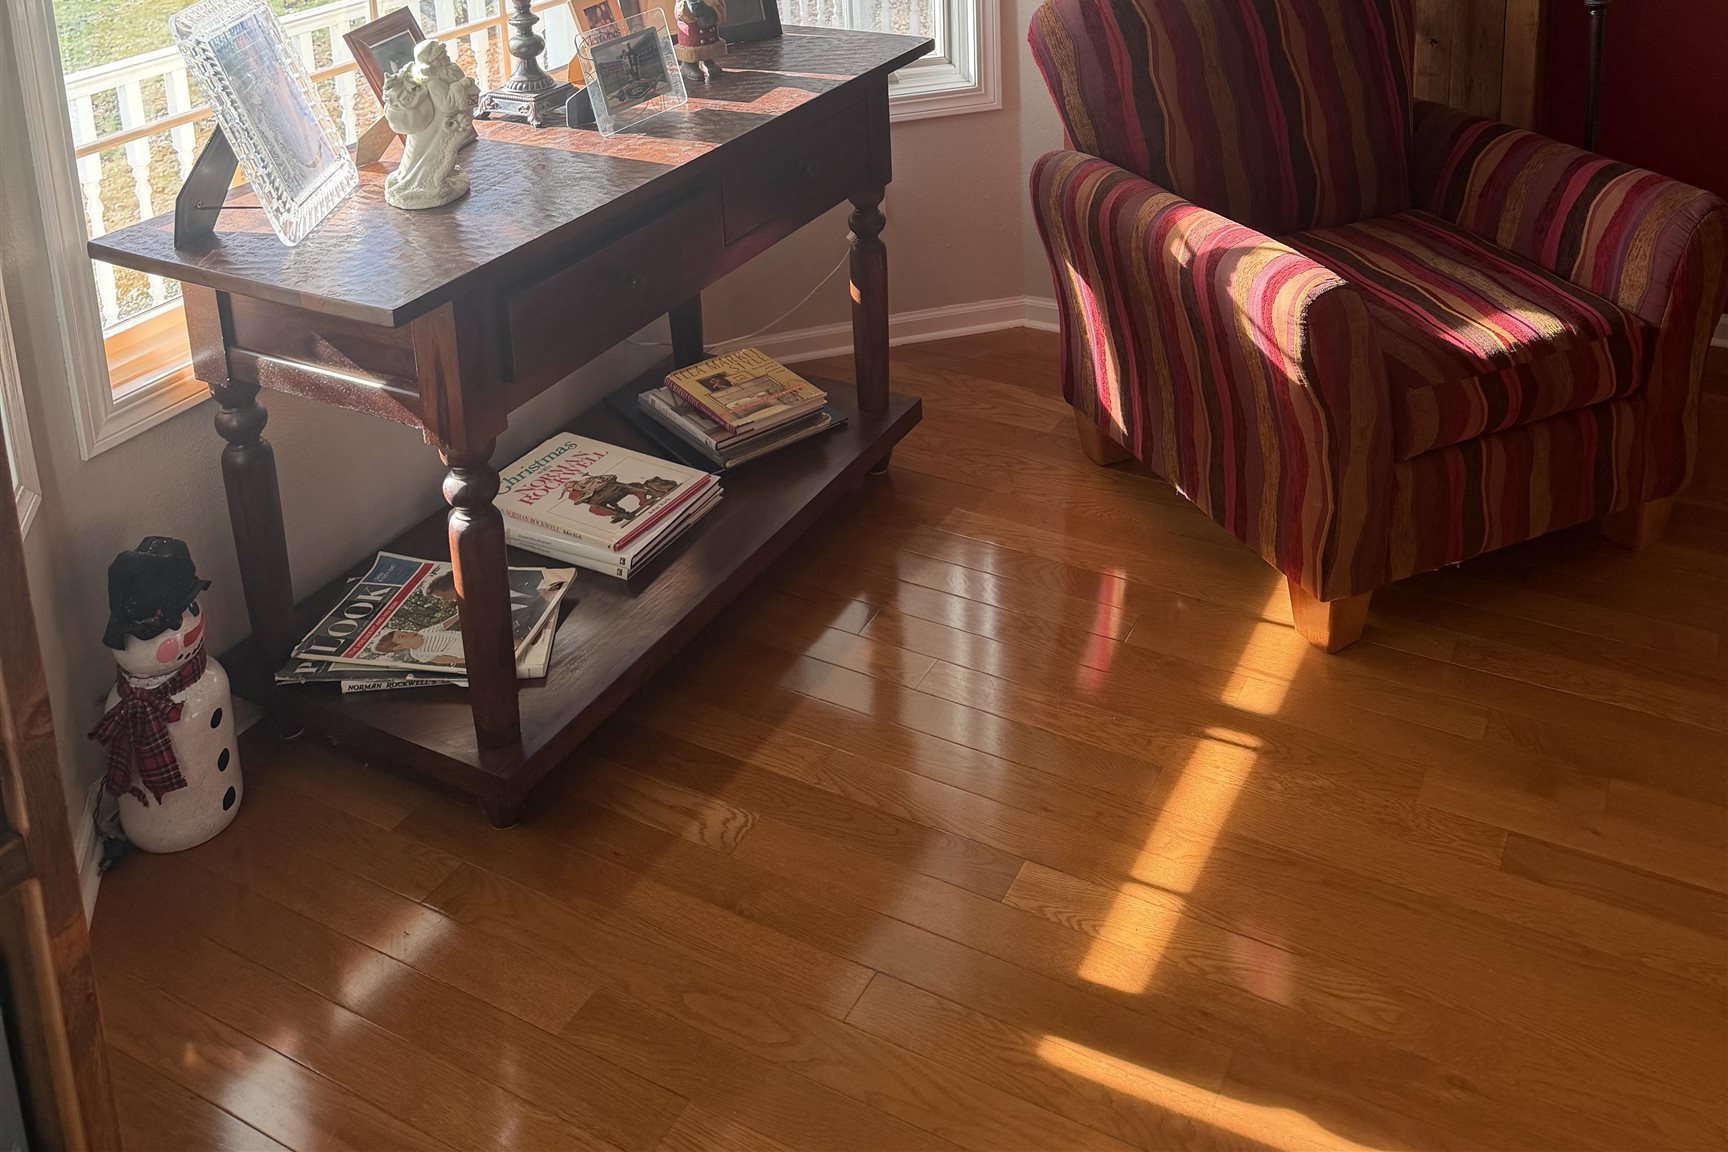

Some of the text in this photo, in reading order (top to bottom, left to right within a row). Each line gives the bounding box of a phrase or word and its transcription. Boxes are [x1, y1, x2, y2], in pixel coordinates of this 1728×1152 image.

[674, 366, 706, 382] FLEA
[708, 348, 761, 371] MARKET
[730, 355, 772, 374] STYLE
[513, 450, 590, 496] NORMAN
[519, 450, 609, 506] ROCKWELL
[309, 586, 394, 653] LOOK
[348, 682, 382, 691] NORMAN
